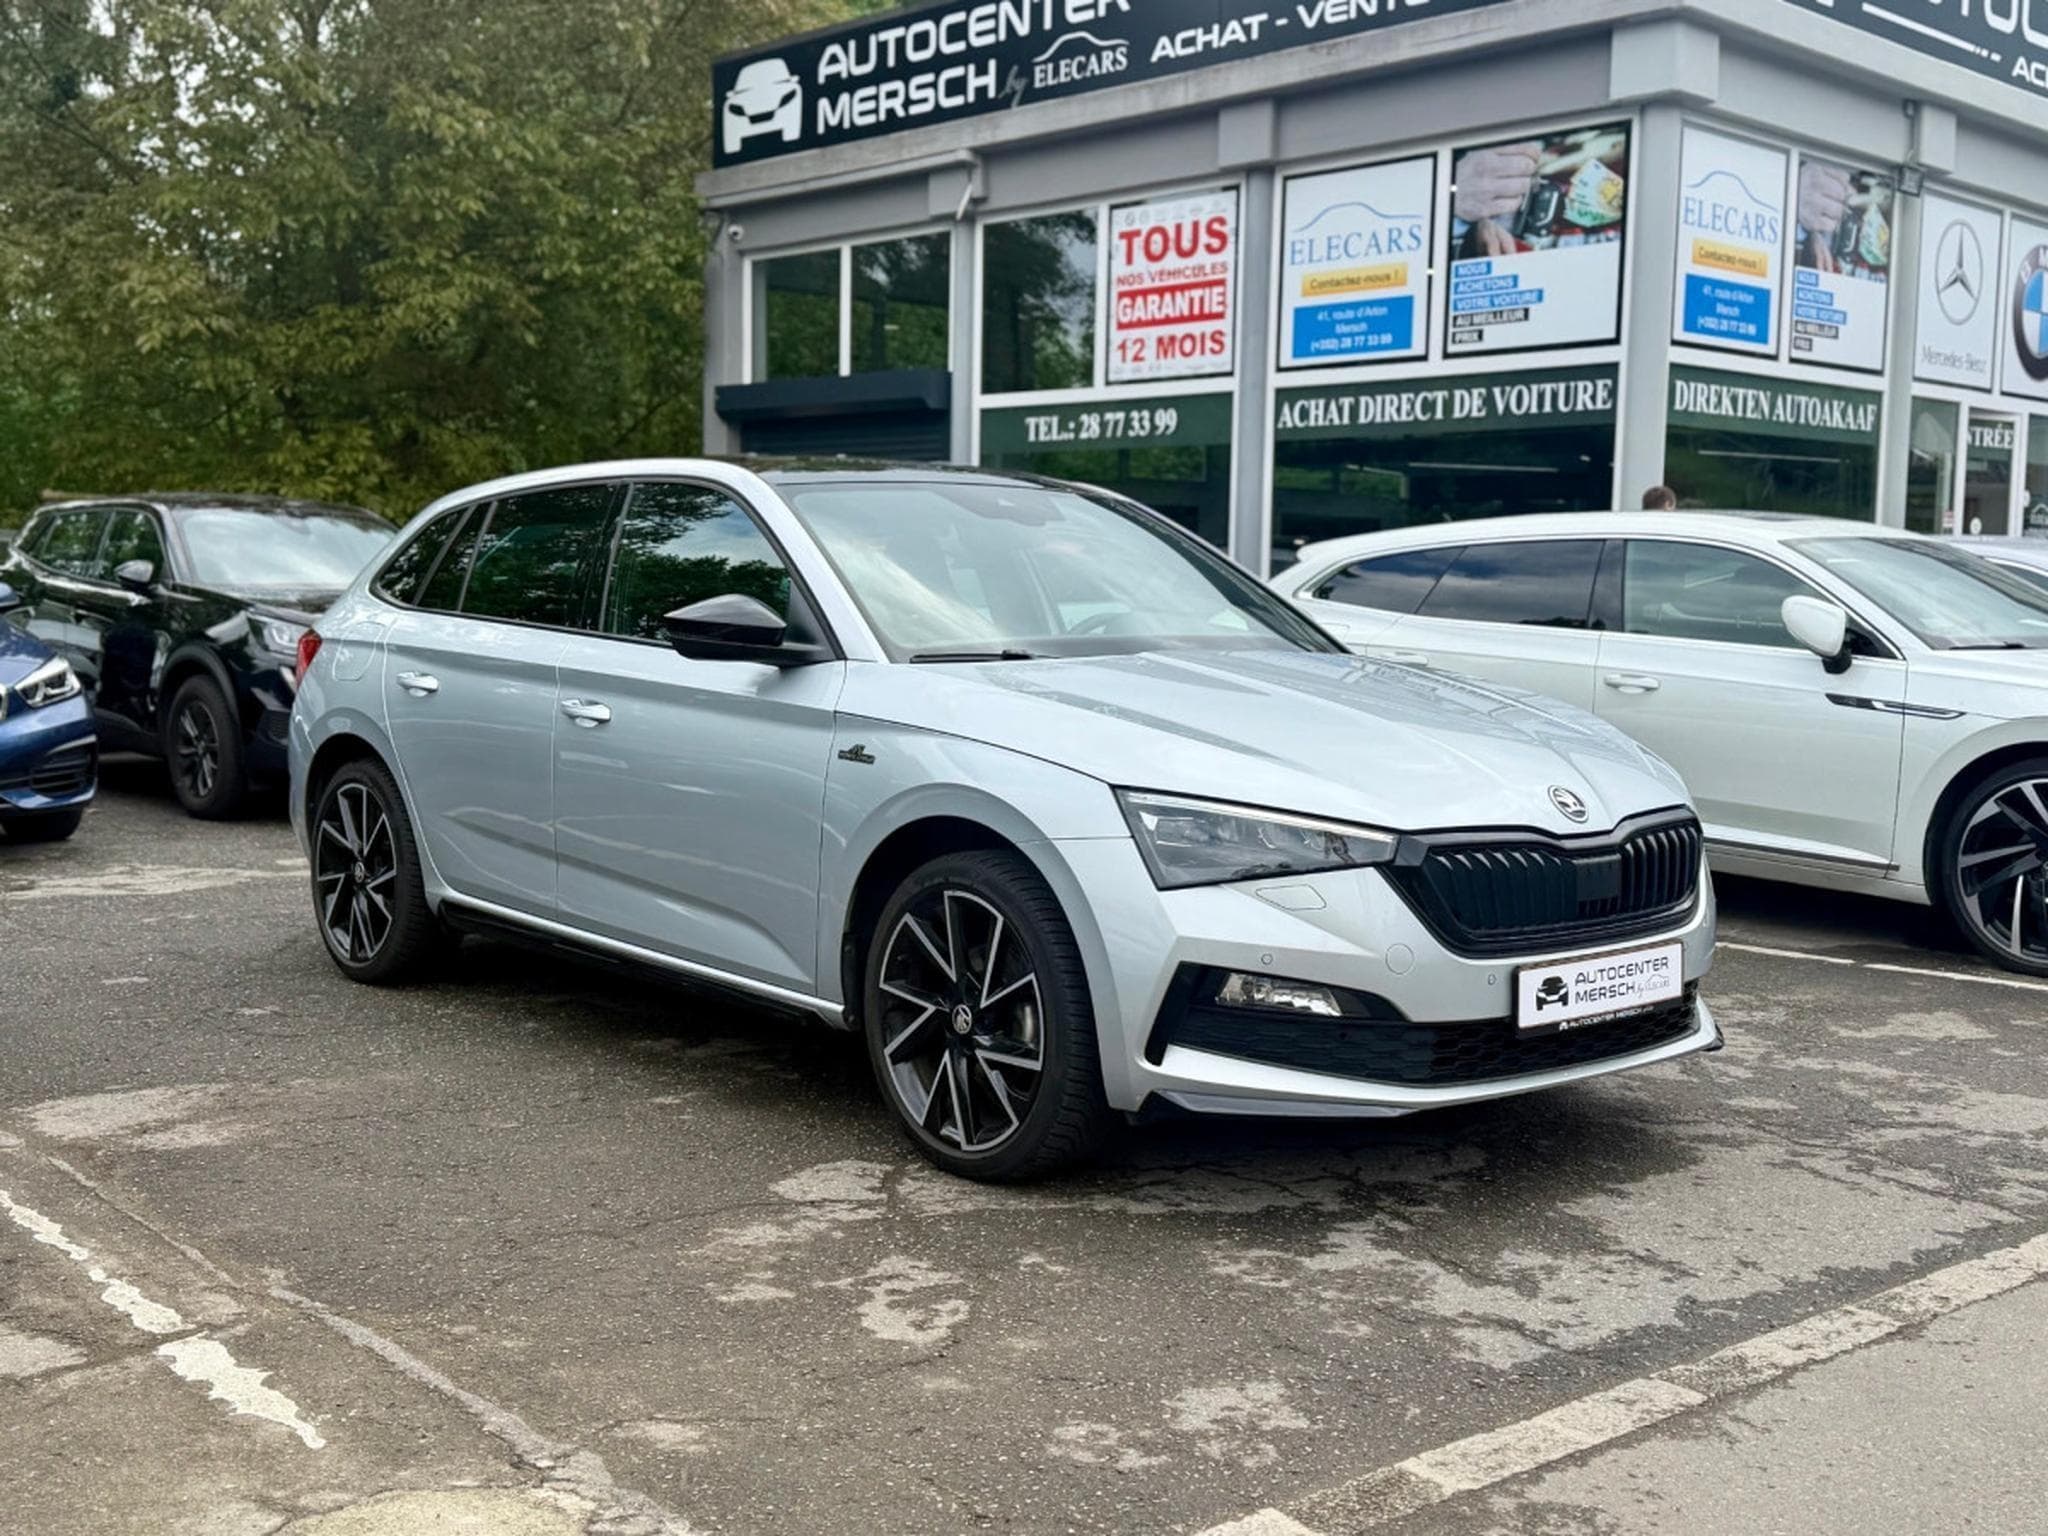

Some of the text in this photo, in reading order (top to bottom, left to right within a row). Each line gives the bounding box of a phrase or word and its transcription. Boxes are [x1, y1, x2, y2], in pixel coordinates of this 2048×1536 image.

[1151, 13, 1268, 63] ACHAT
[817, 46, 1128, 135] MERSCH by ELECARS
[1118, 215, 1229, 266] TOUS
[1682, 196, 1778, 244] ELECARS
[1290, 224, 1423, 266] ELECARS
[1116, 272, 1145, 287] NOS
[1118, 287, 1225, 323] GARANTIE
[1117, 330, 1226, 363] 12 MOIS
[1079, 413, 1101, 439] 28
[1103, 410, 1126, 438] 77
[1128, 409, 1151, 437] 33
[1154, 407, 1178, 435] 99
[1277, 378, 1613, 428] ACHAT DIRECT DE VOITURE
[1674, 380, 1877, 432] DIREKTEN AUTOAKAAF
[1575, 957, 1669, 986] AUTOCENTER
[1575, 981, 1637, 1005] MERSCH
